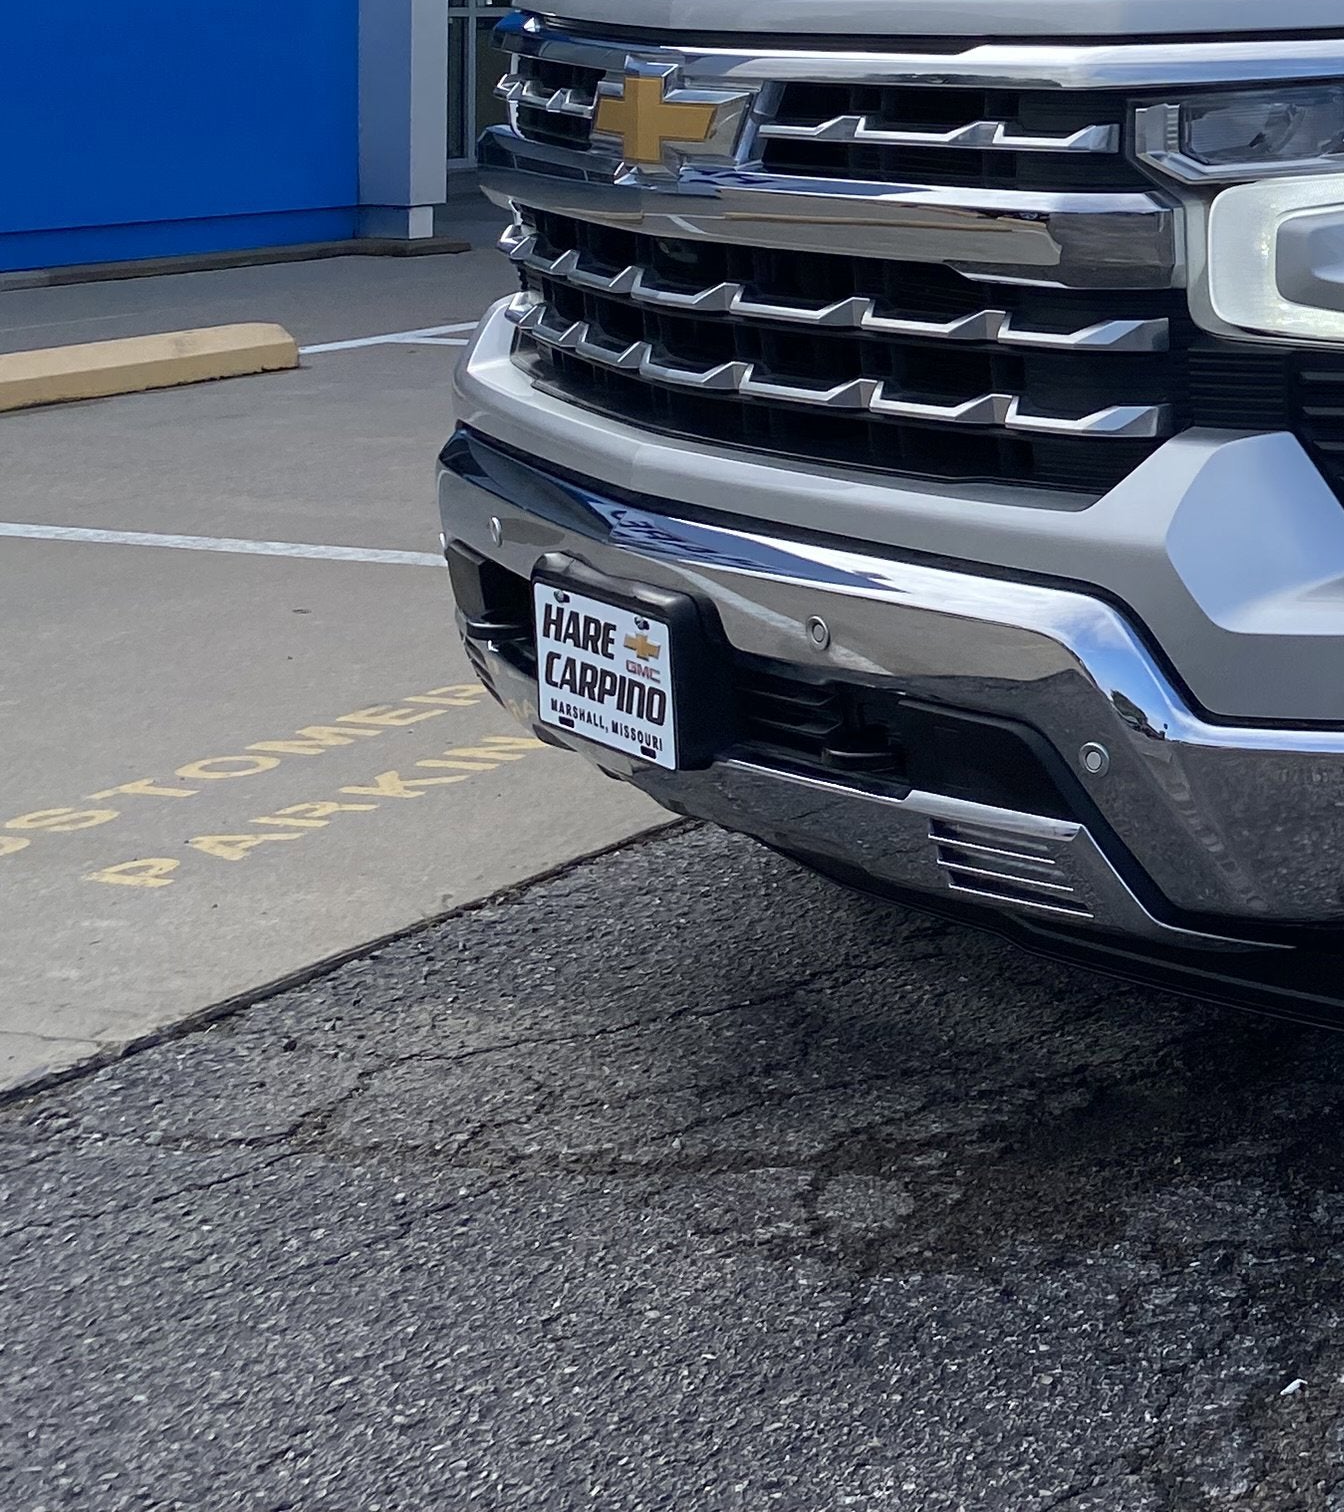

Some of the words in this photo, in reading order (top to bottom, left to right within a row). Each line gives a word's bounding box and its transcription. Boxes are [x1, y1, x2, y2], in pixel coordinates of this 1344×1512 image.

[542, 602, 617, 660] HARE
[545, 650, 667, 727] CARPINO
[625, 659, 661, 684] GMC
[550, 697, 609, 734] MARSHALL,
[611, 719, 663, 752] MISSOURI
[0, 683, 488, 858] STOMER
[82, 736, 552, 888] PARKIN
